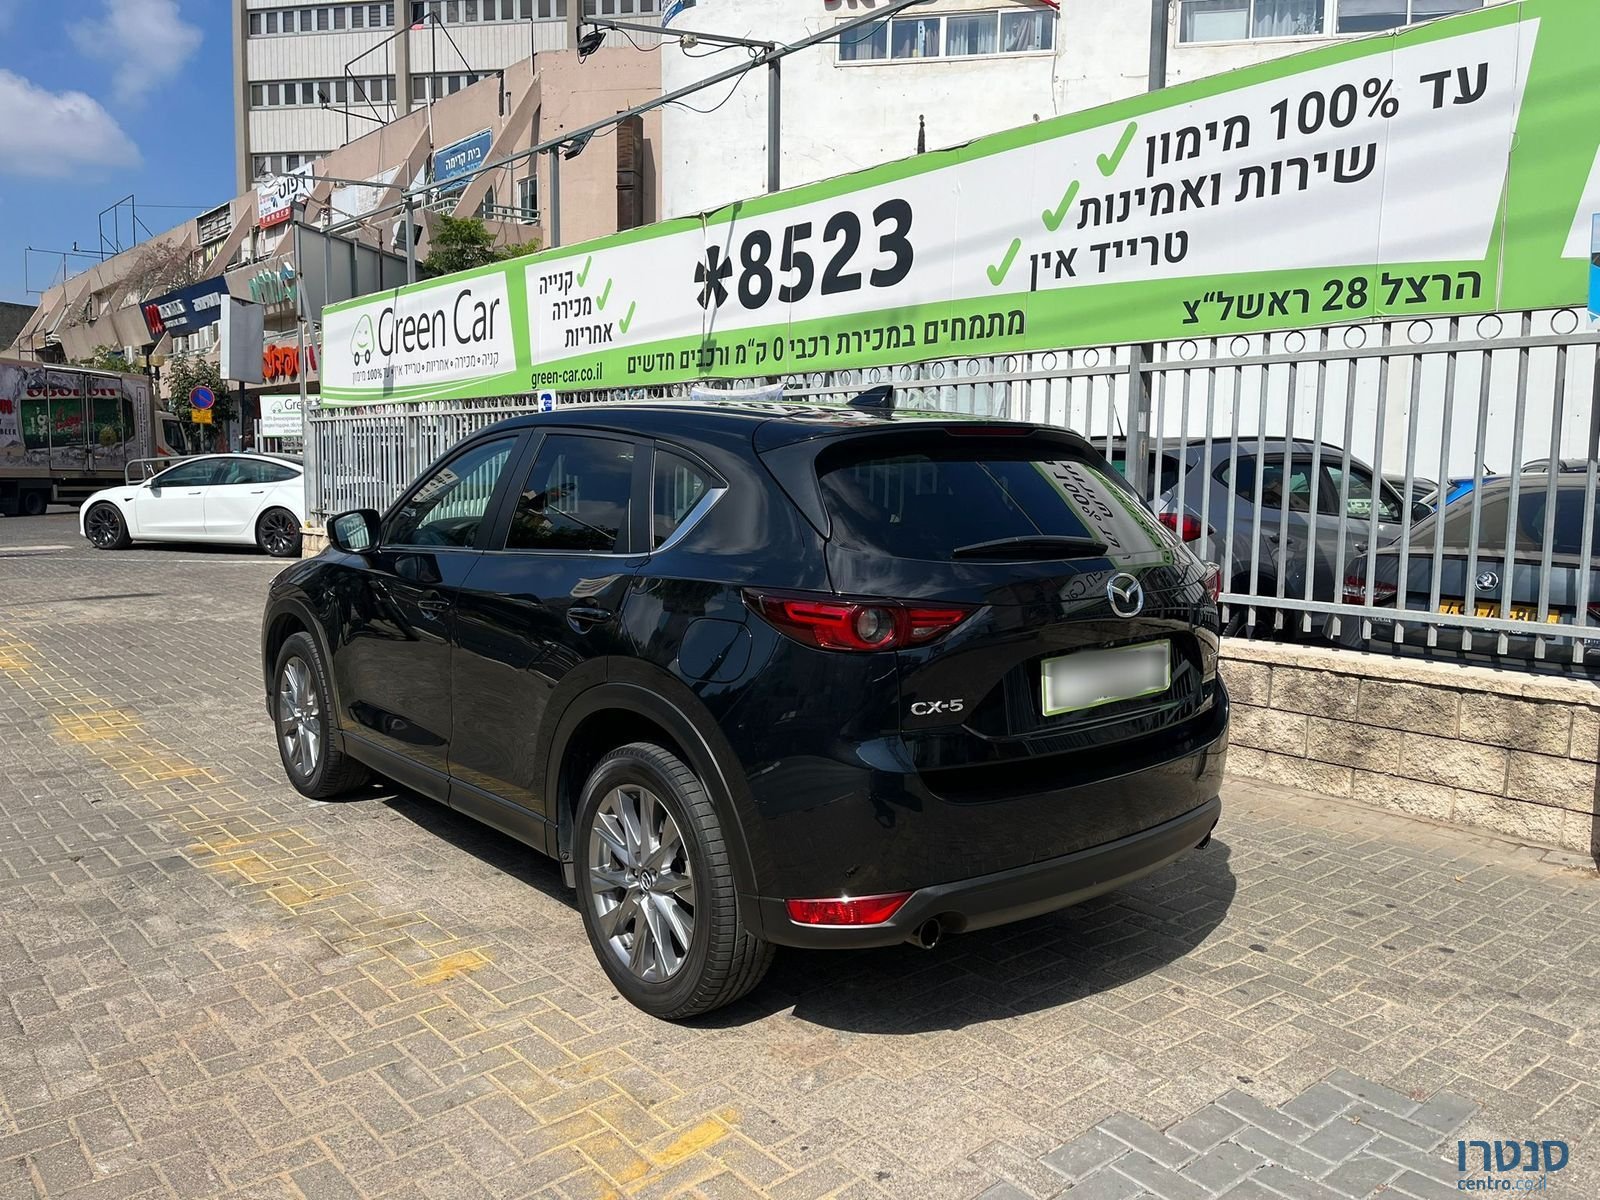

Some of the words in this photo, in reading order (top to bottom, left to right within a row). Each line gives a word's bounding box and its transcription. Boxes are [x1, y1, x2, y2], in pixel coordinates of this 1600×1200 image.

[1419, 62, 1489, 109] עד
[1270, 77, 1399, 141] 100%
[1146, 114, 1250, 178] מימון
[1235, 142, 1377, 202] שירות
[1077, 172, 1222, 230] ואמינות
[1090, 230, 1189, 273] טרייד
[539, 270, 573, 296] קנייה
[1029, 247, 1078, 292] אין
[1322, 276, 1367, 311] 28
[1381, 270, 1481, 306] הרצל
[378, 307, 446, 357] Green
[453, 289, 500, 345] Car
[552, 296, 592, 321] מכירה
[565, 322, 613, 348] אחריות
[836, 323, 915, 355] במכירת
[924, 309, 1025, 345] מתמחים
[454, 355, 476, 369] מכירה
[627, 351, 675, 374] חדשים
[679, 347, 730, 369] ורכבים
[773, 336, 784, 361] 0
[789, 335, 830, 360] רכבי
[367, 368, 383, 381] 100%
[425, 358, 449, 373] אחריות
[531, 361, 603, 389] green-car.co.il
[910, 698, 964, 716] CX-5
